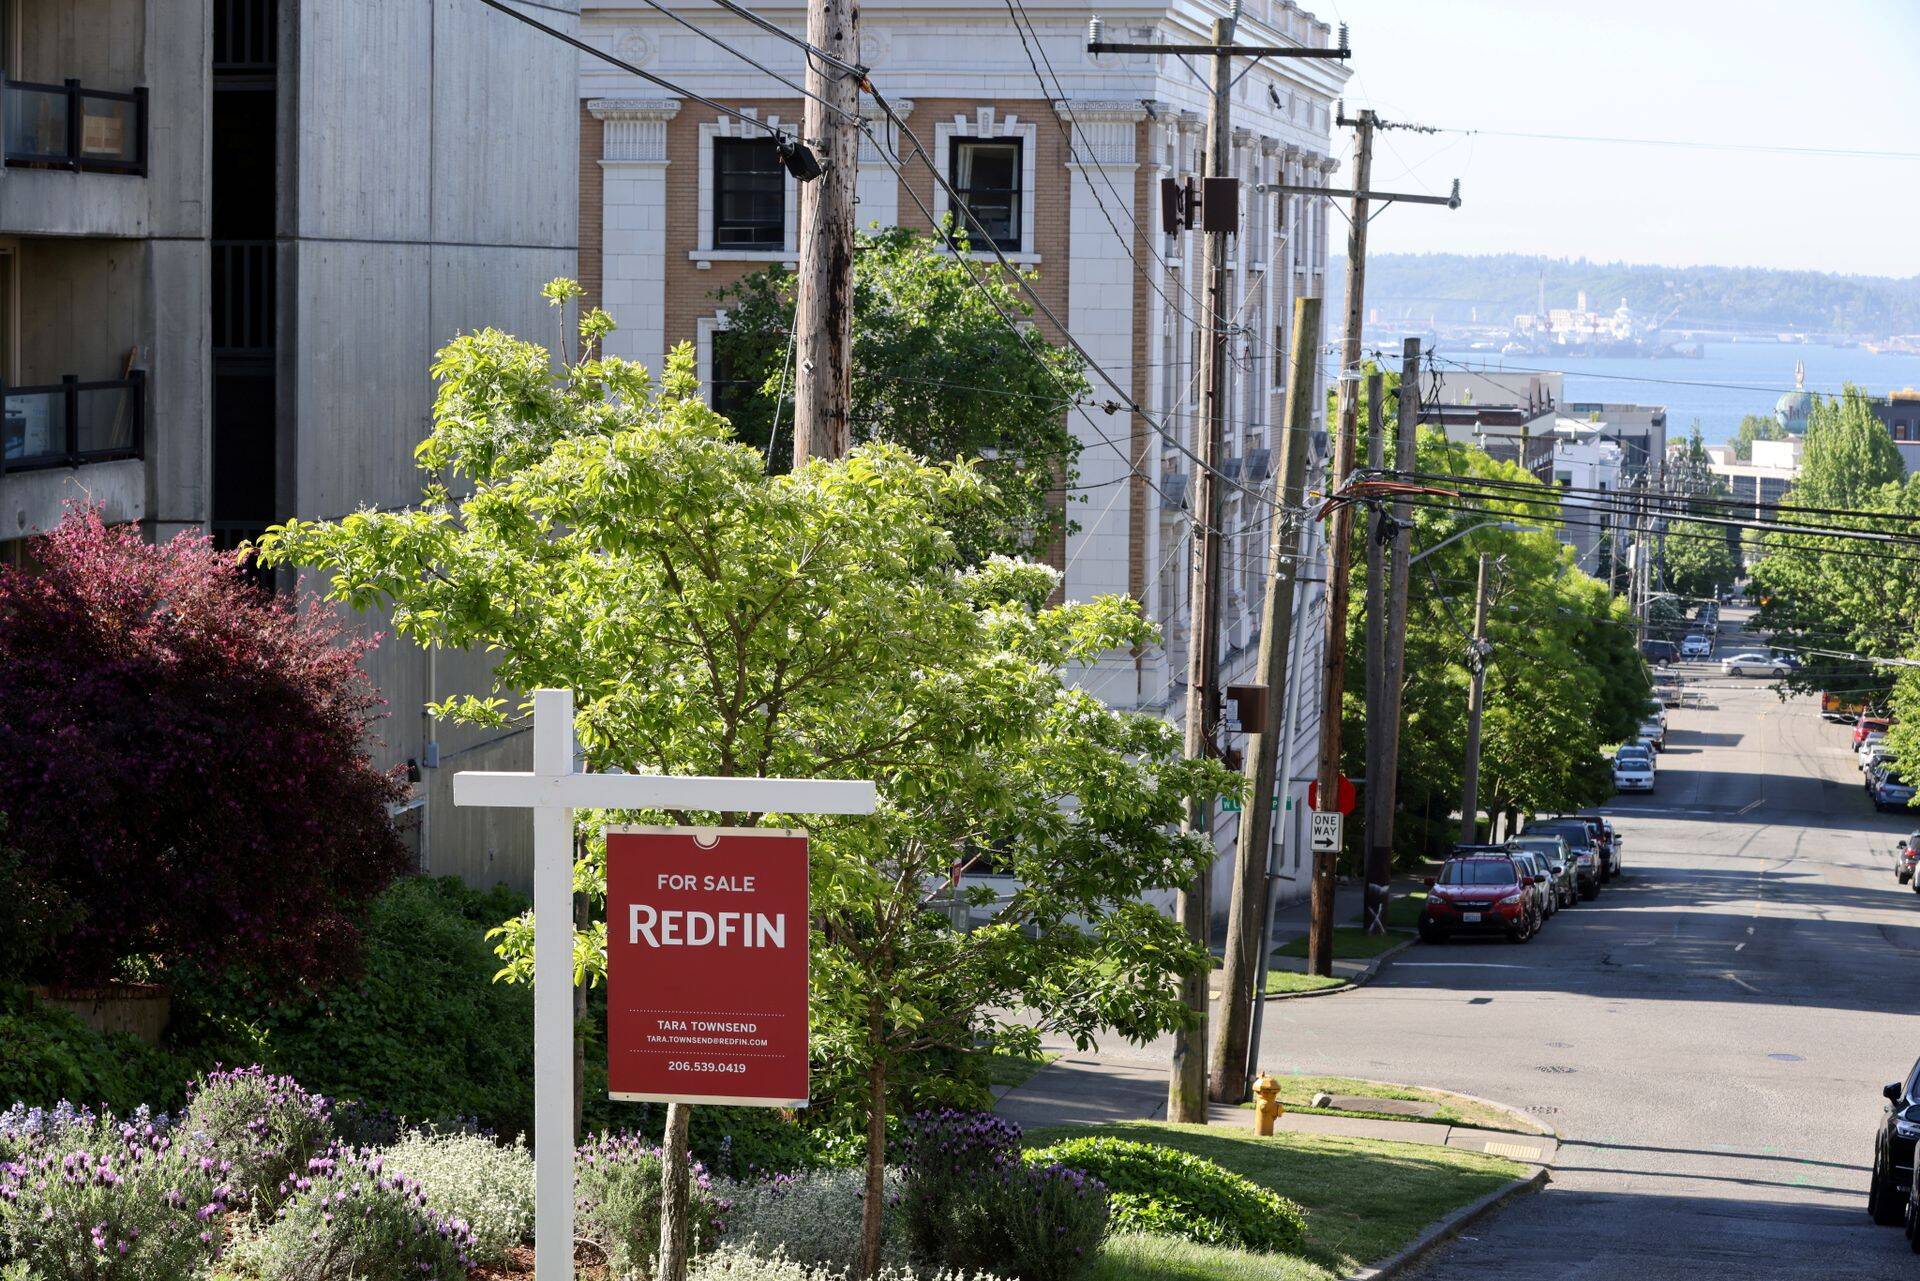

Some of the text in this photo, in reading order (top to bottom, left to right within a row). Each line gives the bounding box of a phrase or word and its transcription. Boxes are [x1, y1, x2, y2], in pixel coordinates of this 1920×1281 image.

[1314, 815, 1337, 826] ONE
[1314, 826, 1337, 836] WAY
[657, 873, 756, 893] FOR SALE
[628, 903, 786, 949] REDFIN
[656, 1020, 757, 1033] TARA TOWNSEND
[646, 1035, 768, 1047] TARA.TOWNSEND@REDFIN.COM
[668, 1060, 746, 1074] 206.539.0419
